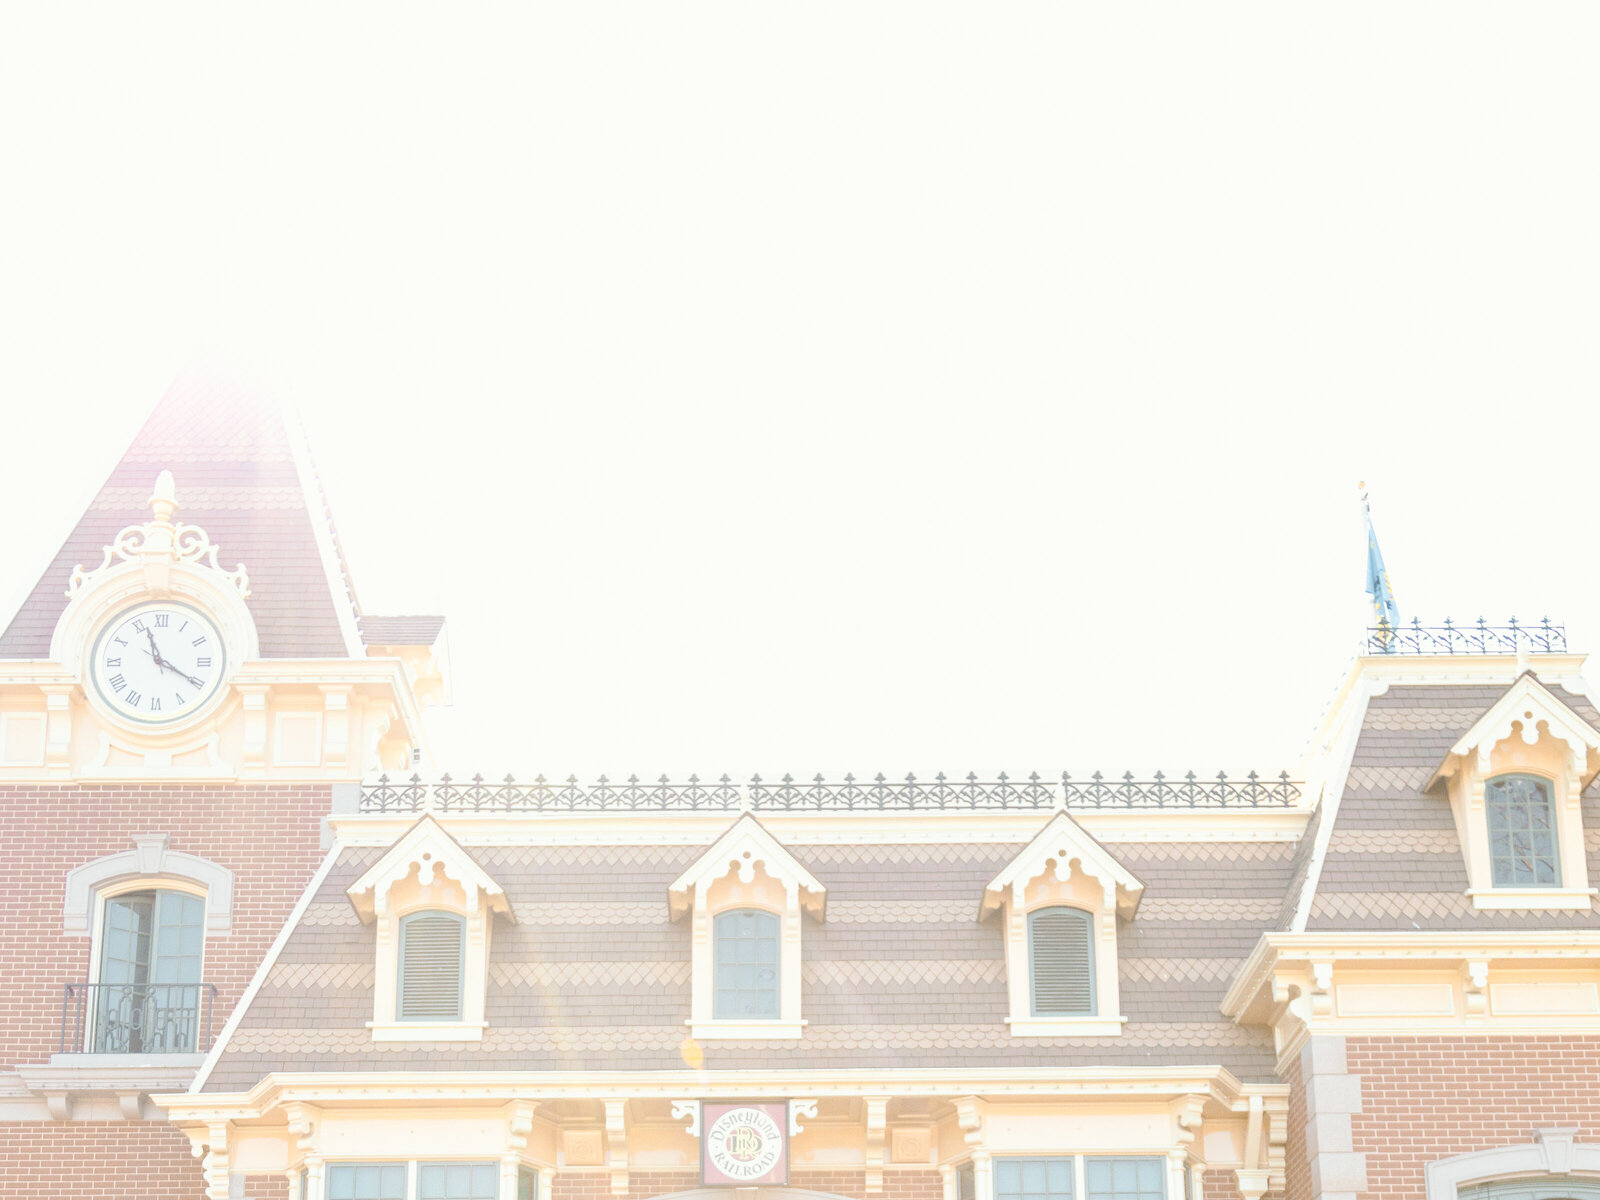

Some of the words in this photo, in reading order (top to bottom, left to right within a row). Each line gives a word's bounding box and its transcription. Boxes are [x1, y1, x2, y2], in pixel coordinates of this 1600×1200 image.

[154, 614, 169, 628] XII
[179, 620, 189, 632] I
[114, 636, 129, 647] X
[192, 636, 206, 647] II
[107, 657, 121, 667] IX
[197, 657, 211, 667] III
[109, 674, 127, 693] VIII
[125, 690, 142, 707] VII
[151, 697, 161, 711] VI
[175, 692, 185, 705] V
[711, 1111, 780, 1141] Disneyland
[714, 1152, 775, 1176] RAILROAD
